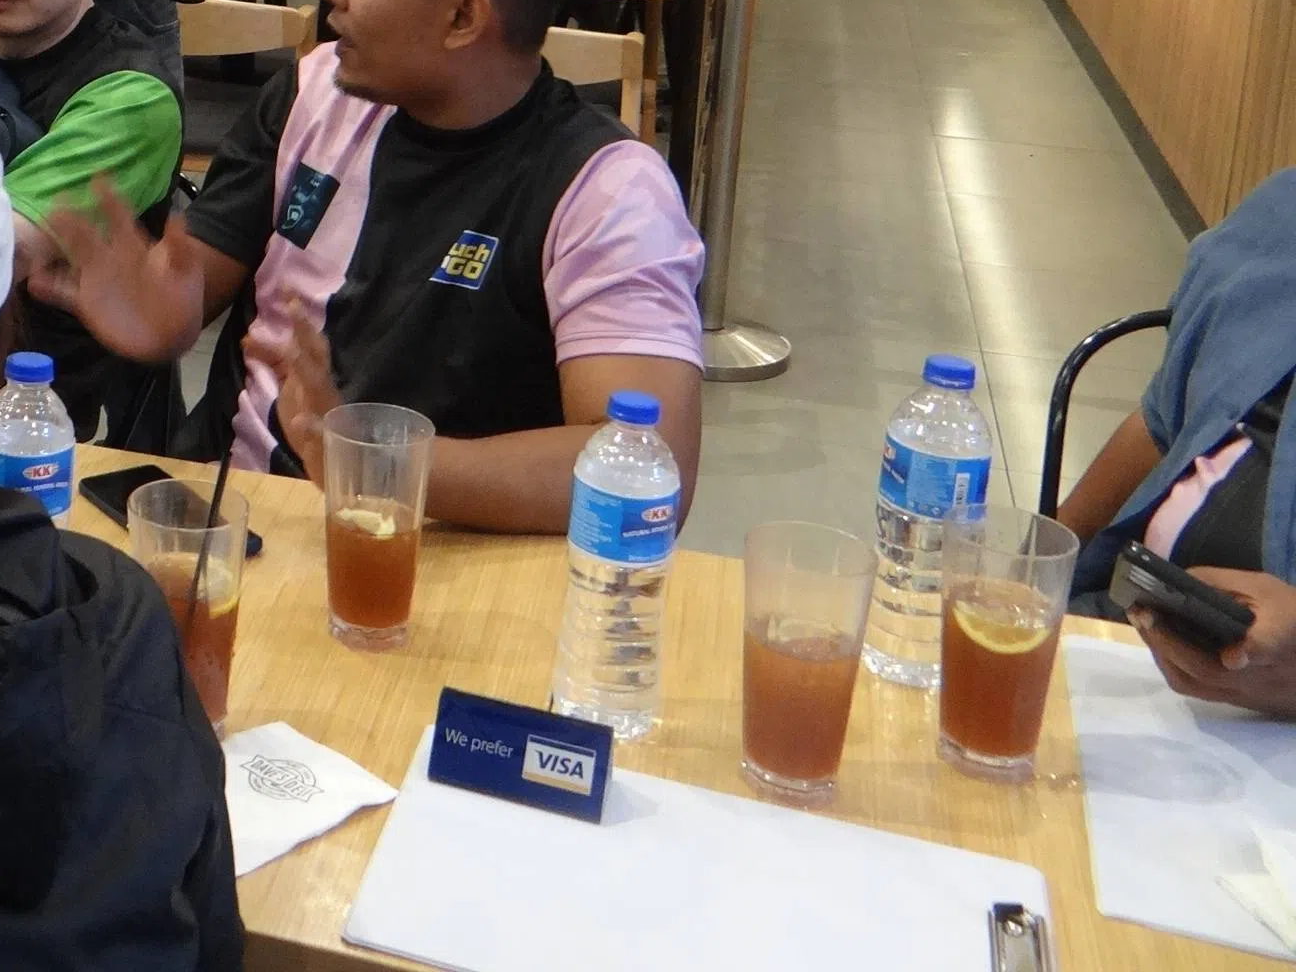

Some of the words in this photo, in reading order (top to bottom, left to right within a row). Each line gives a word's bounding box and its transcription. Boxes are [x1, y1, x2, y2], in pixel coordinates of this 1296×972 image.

[32, 465, 51, 478] KK
[445, 727, 469, 746] We
[470, 736, 514, 759] prefer
[534, 749, 585, 780] VISA
